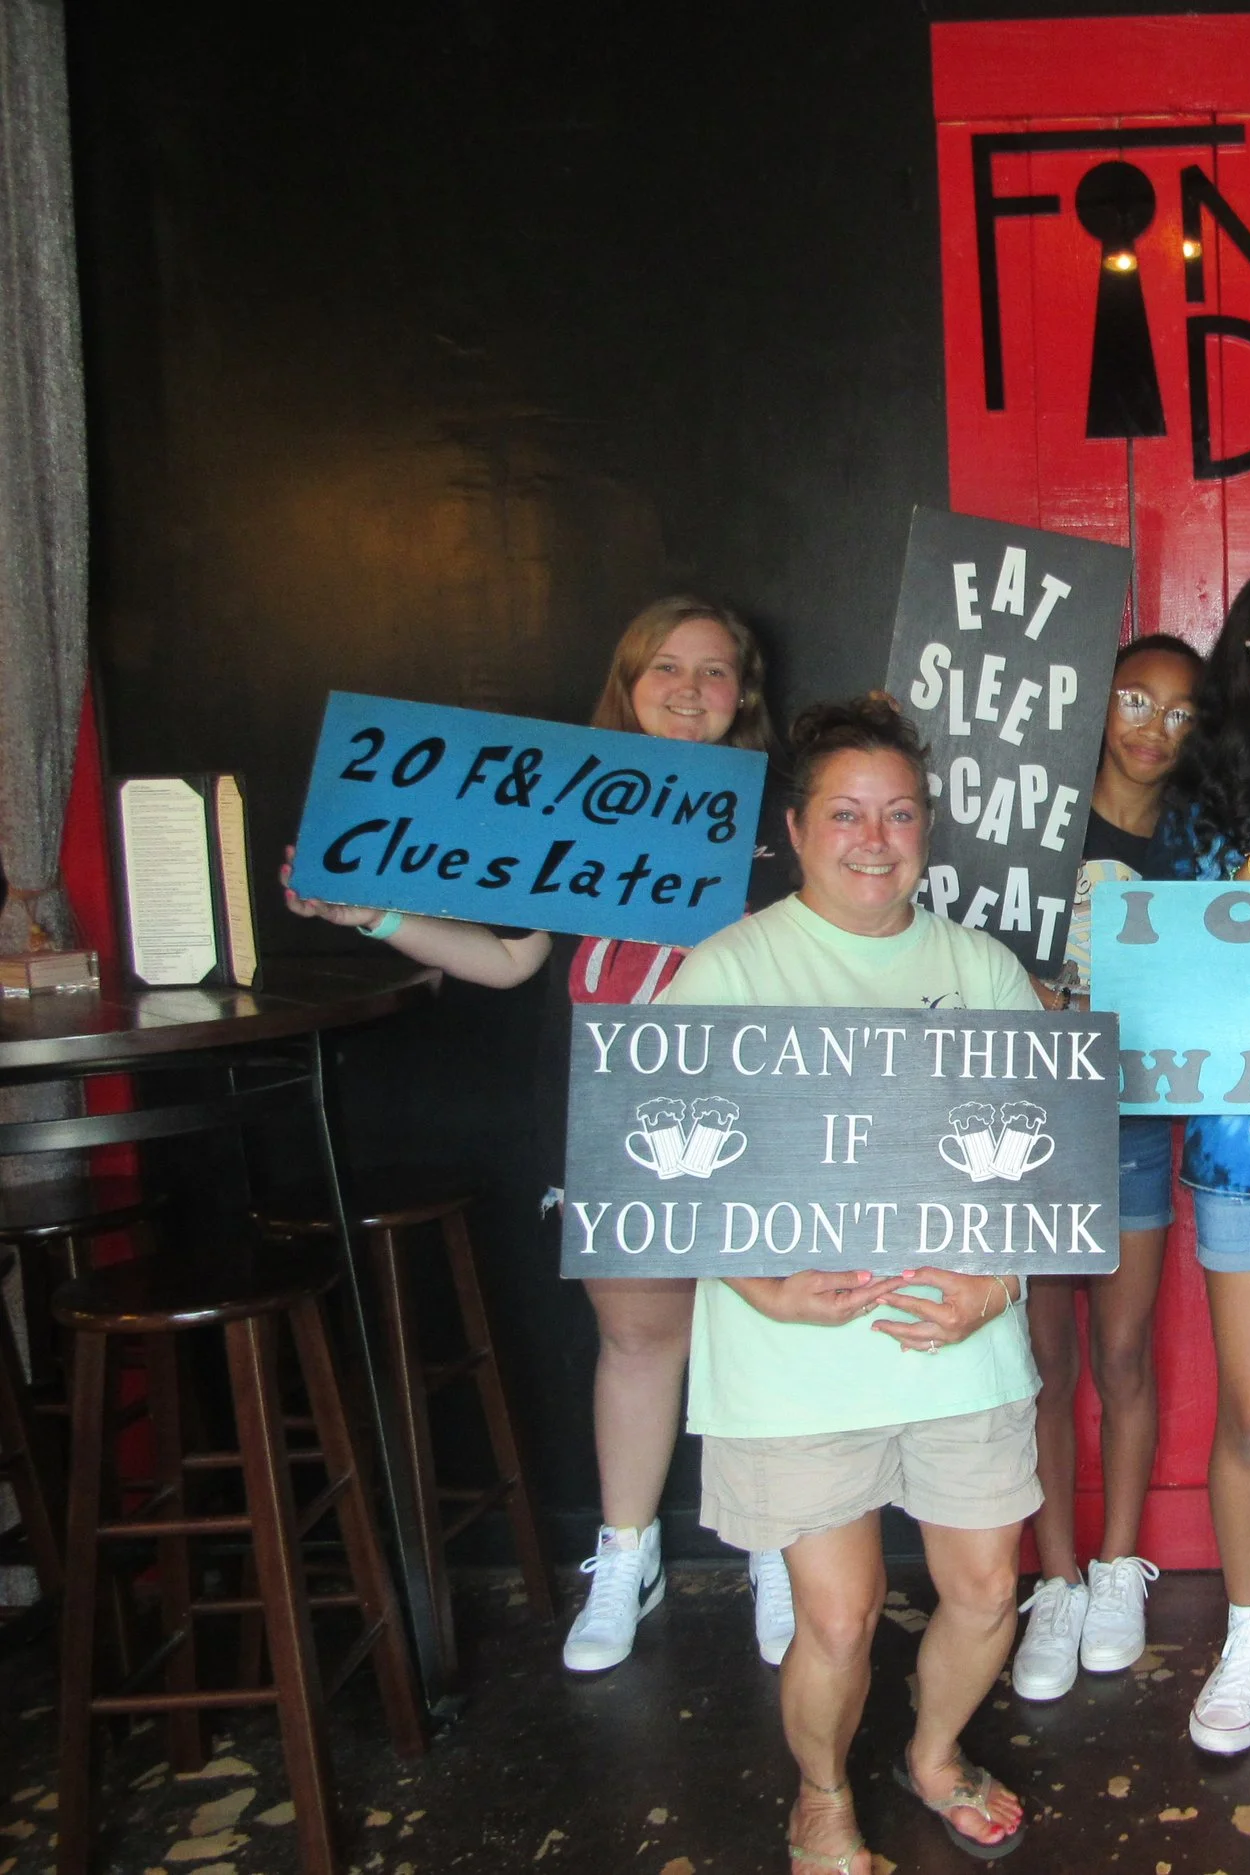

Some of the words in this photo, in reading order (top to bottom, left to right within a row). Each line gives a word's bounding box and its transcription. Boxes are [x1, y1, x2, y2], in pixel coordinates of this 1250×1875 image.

[953, 546, 1071, 640] EAT
[910, 643, 1077, 746] SLEEP
[340, 727, 446, 787] 20
[927, 756, 1079, 852] CAPE
[322, 818, 518, 888] Clues
[529, 840, 721, 907] Later
[1116, 891, 1159, 944] I
[586, 1022, 714, 1075] YOU
[732, 1025, 906, 1078] CAN'T
[924, 1029, 1106, 1081] THINK
[820, 1114, 873, 1164] IF
[572, 1201, 702, 1255] YOU
[720, 1202, 898, 1255] DON'T
[916, 1203, 1106, 1254] DRINK
